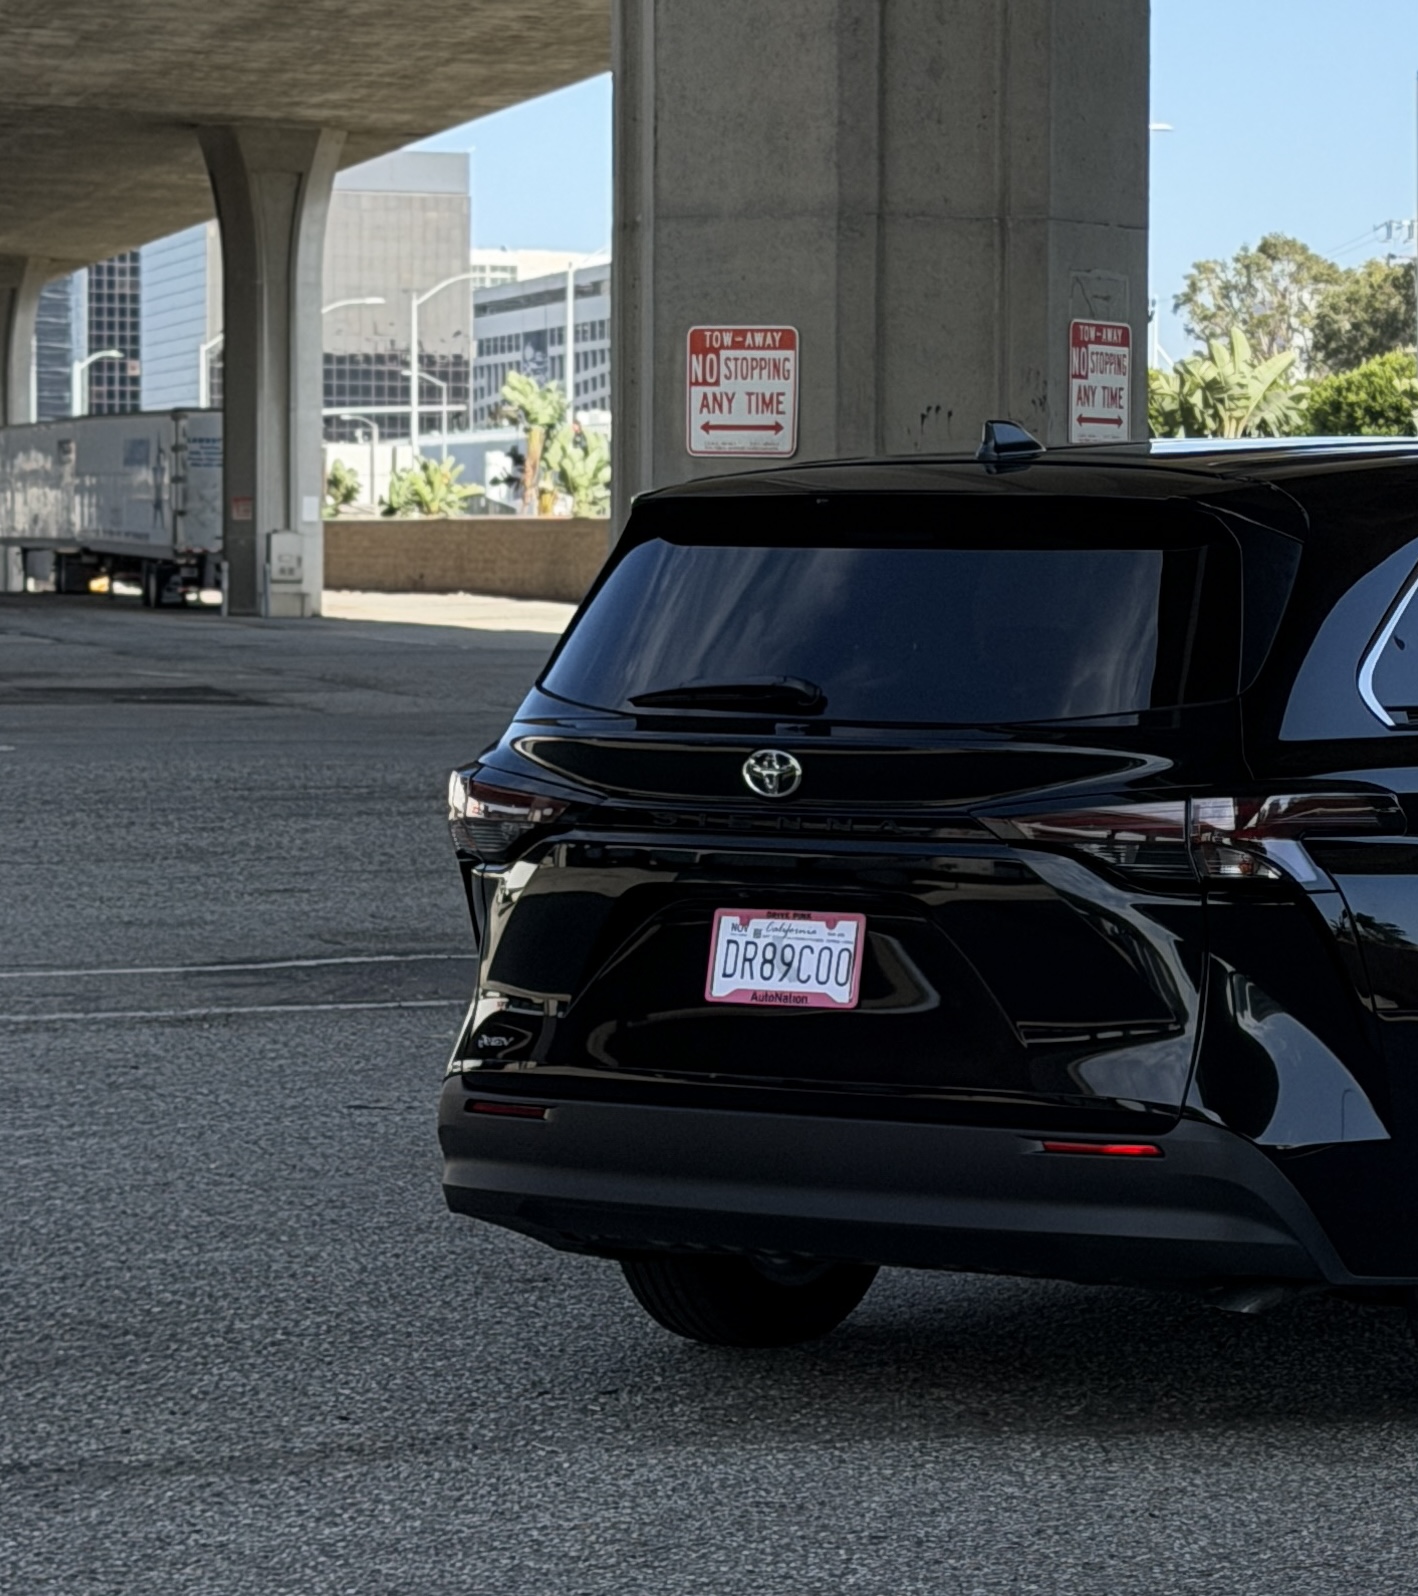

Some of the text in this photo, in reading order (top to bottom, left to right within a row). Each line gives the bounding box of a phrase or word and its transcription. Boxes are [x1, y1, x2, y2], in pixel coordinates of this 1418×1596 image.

[704, 331, 782, 348] TOW-AWAY
[1079, 325, 1123, 343] TOW-AWAY
[691, 353, 791, 383] NO STOPPING
[1072, 346, 1127, 376] NO STOPPING
[699, 391, 787, 415] ANY TIME
[1076, 384, 1125, 410] ANY TIME
[648, 811, 902, 833] SIENNA
[766, 911, 812, 920] DRIVE PINK
[765, 921, 817, 939] California
[750, 990, 809, 1004] AutoNation
